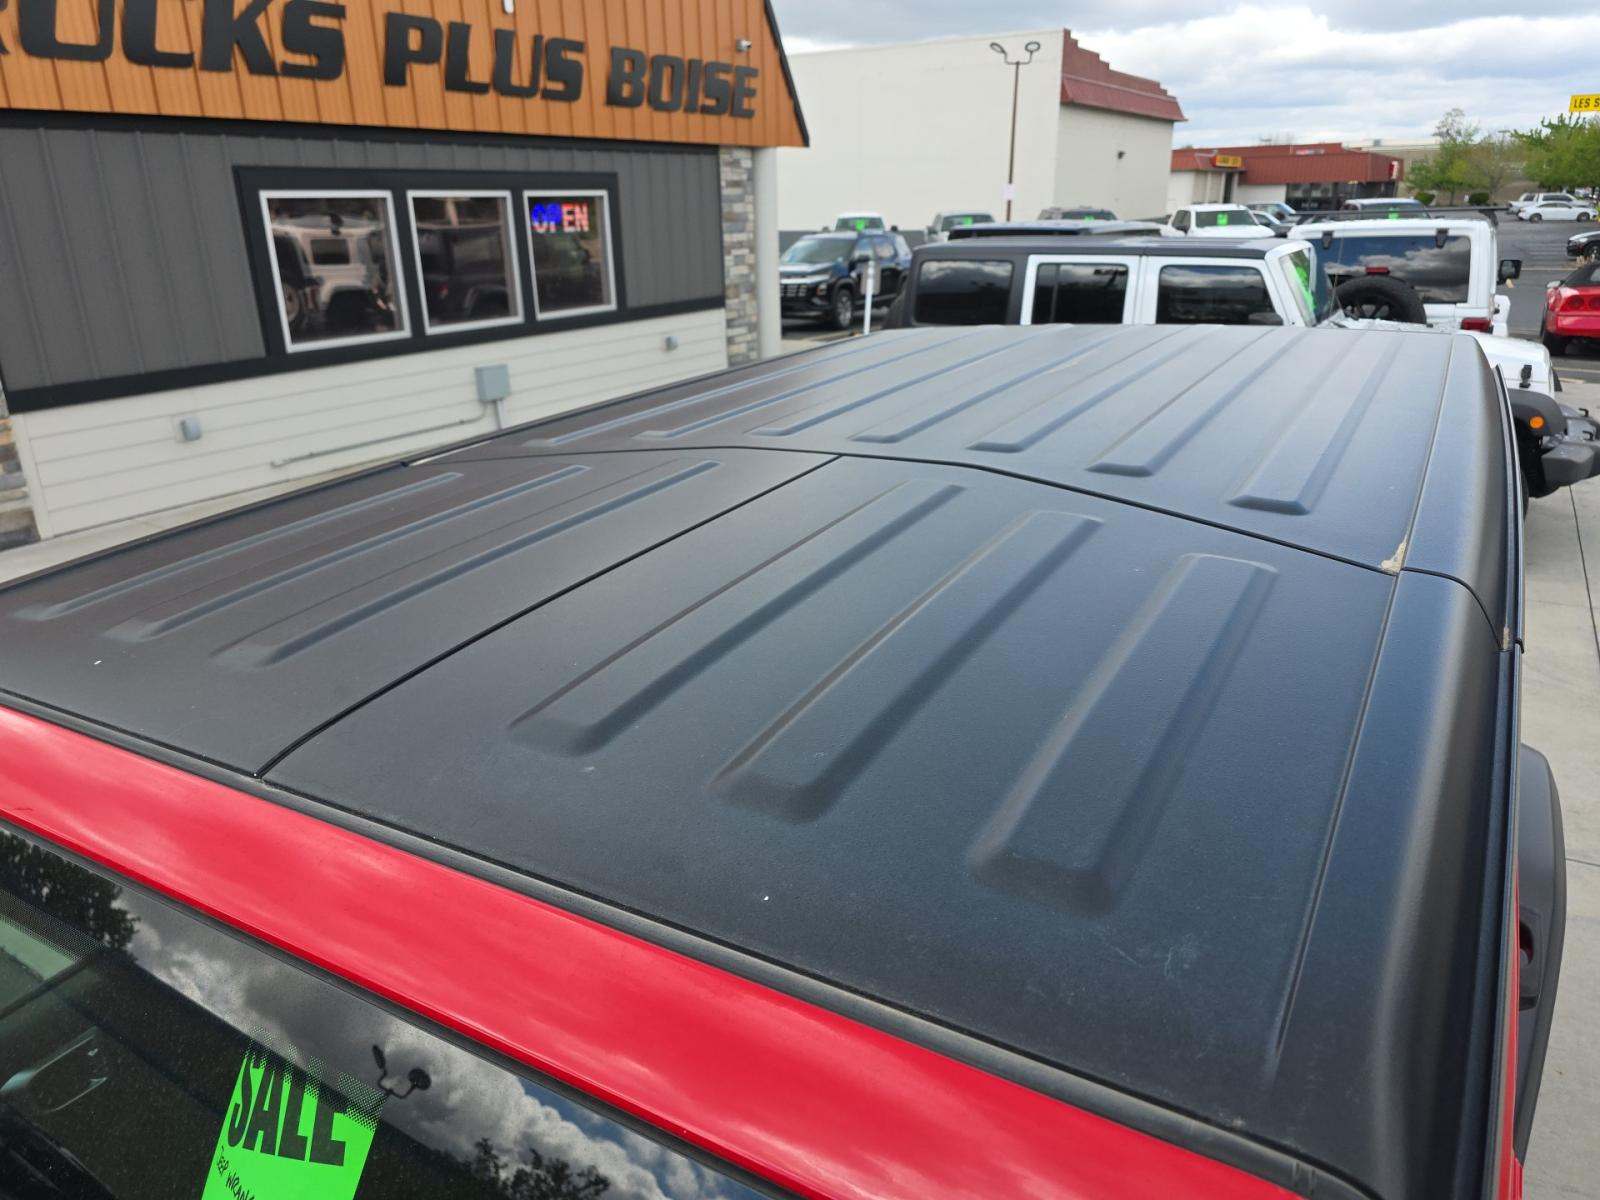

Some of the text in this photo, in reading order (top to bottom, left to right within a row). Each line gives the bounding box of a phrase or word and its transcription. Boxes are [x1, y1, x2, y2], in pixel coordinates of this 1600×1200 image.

[384, 12, 585, 102] PLUS
[605, 46, 759, 118] BOISE
[531, 202, 589, 233] OPEN
